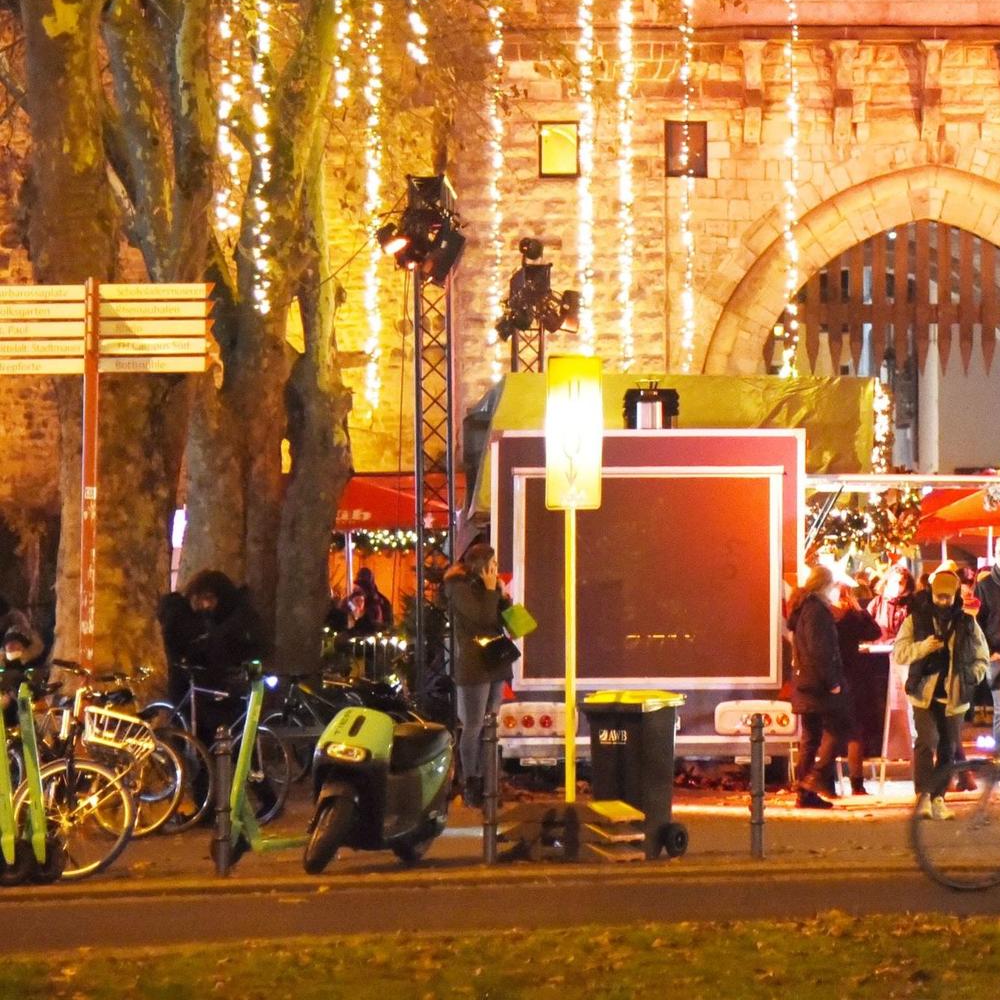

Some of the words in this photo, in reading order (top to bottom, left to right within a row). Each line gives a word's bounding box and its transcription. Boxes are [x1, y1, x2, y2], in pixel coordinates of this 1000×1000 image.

[0, 288, 68, 299] arbarossaplatz
[0, 306, 51, 318] olksgarten
[608, 729, 628, 742] AWB
